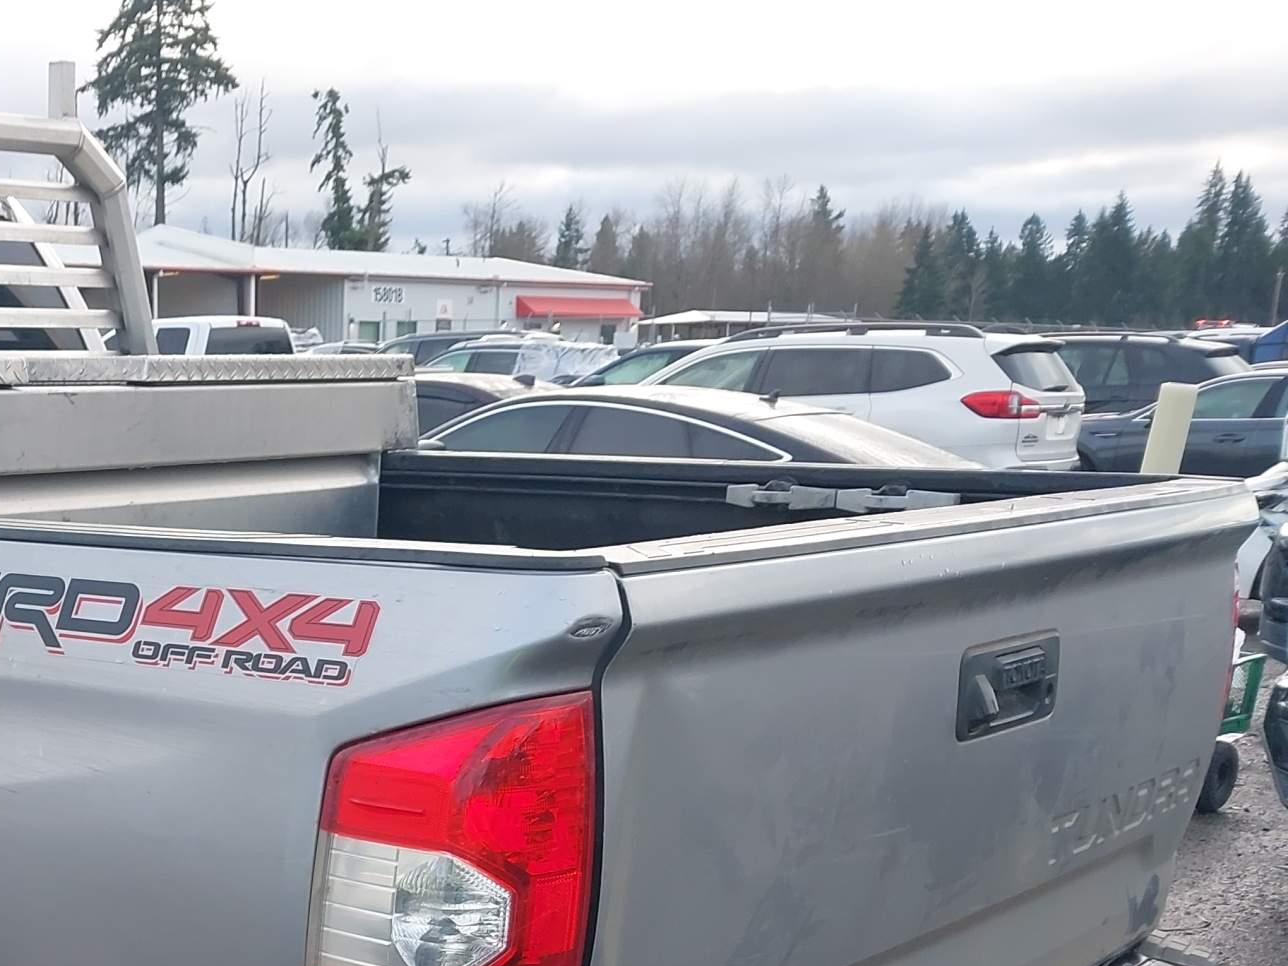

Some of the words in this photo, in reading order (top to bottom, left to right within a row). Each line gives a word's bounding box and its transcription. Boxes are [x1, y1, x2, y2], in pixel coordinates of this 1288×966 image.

[139, 586, 381, 657] 4X4
[131, 640, 216, 668] OFF
[220, 649, 352, 687] ROAD
[1048, 757, 1200, 866] TUNDRA
